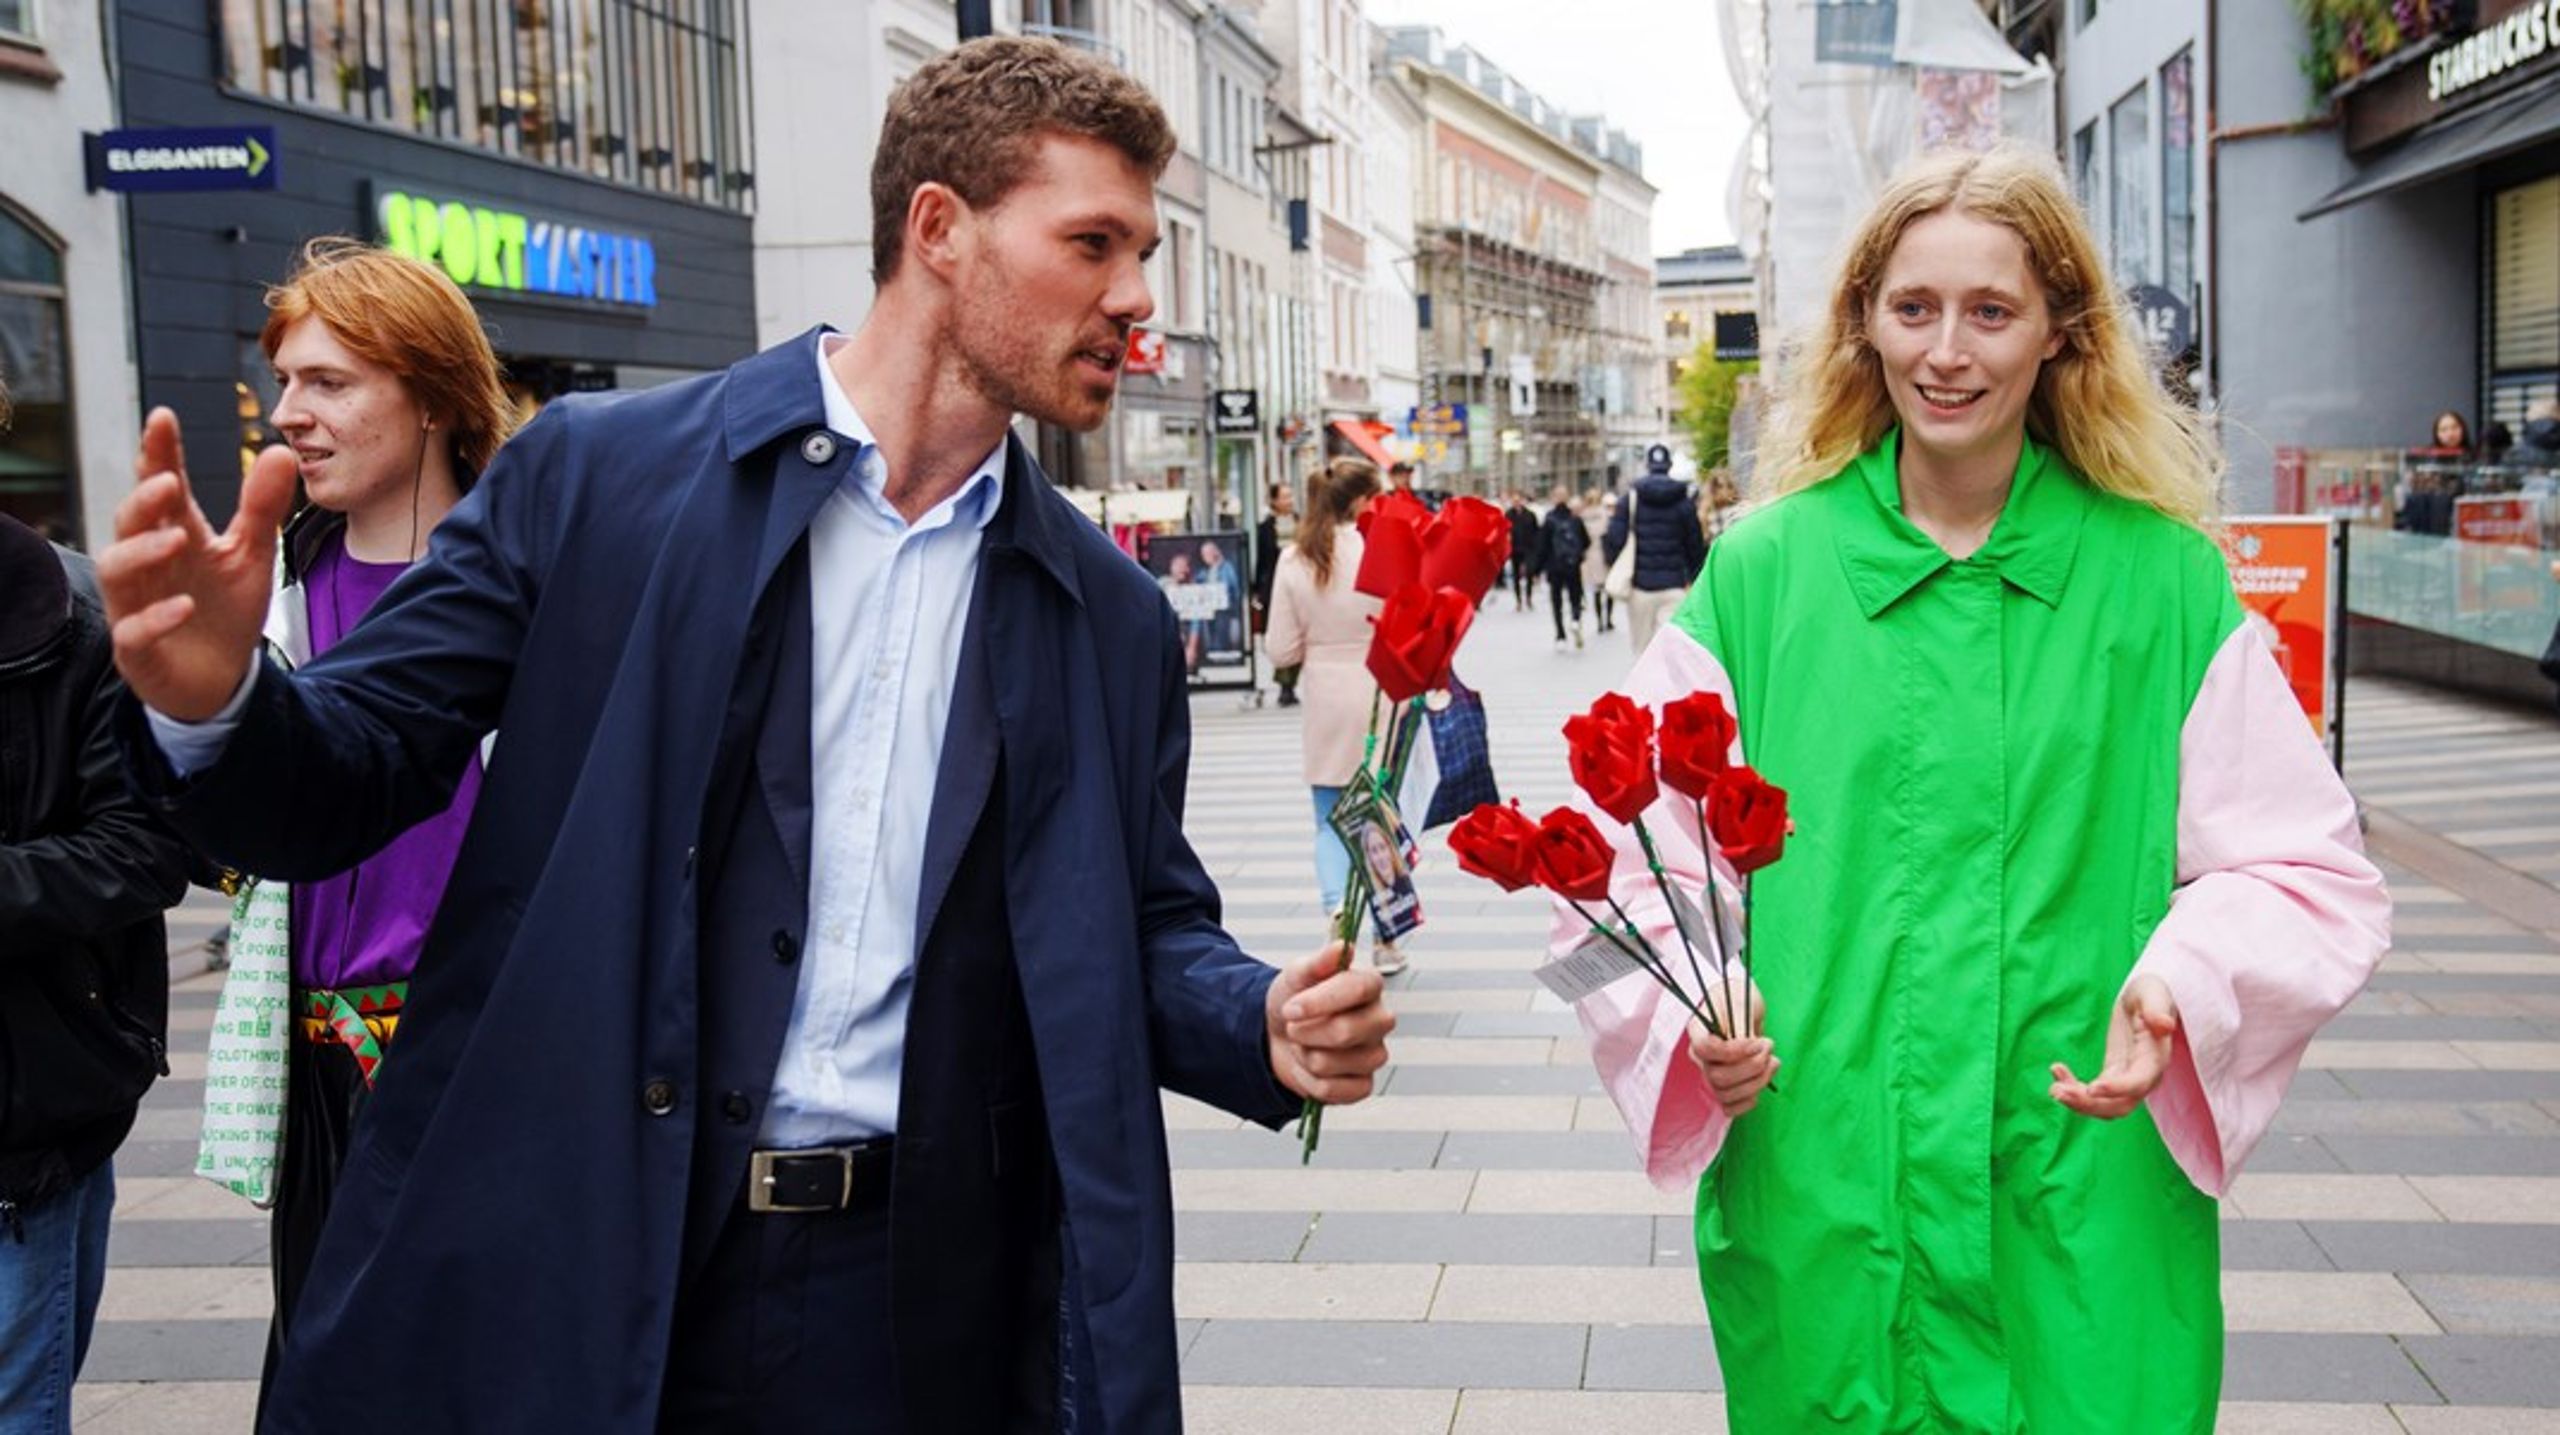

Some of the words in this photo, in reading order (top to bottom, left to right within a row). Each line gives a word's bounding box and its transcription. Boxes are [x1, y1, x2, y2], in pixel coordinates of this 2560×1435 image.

[2427, 2, 2546, 101] STARBUCKS
[107, 146, 249, 171] ELGIGANTEN
[217, 1048, 281, 1062] CLOTHING
